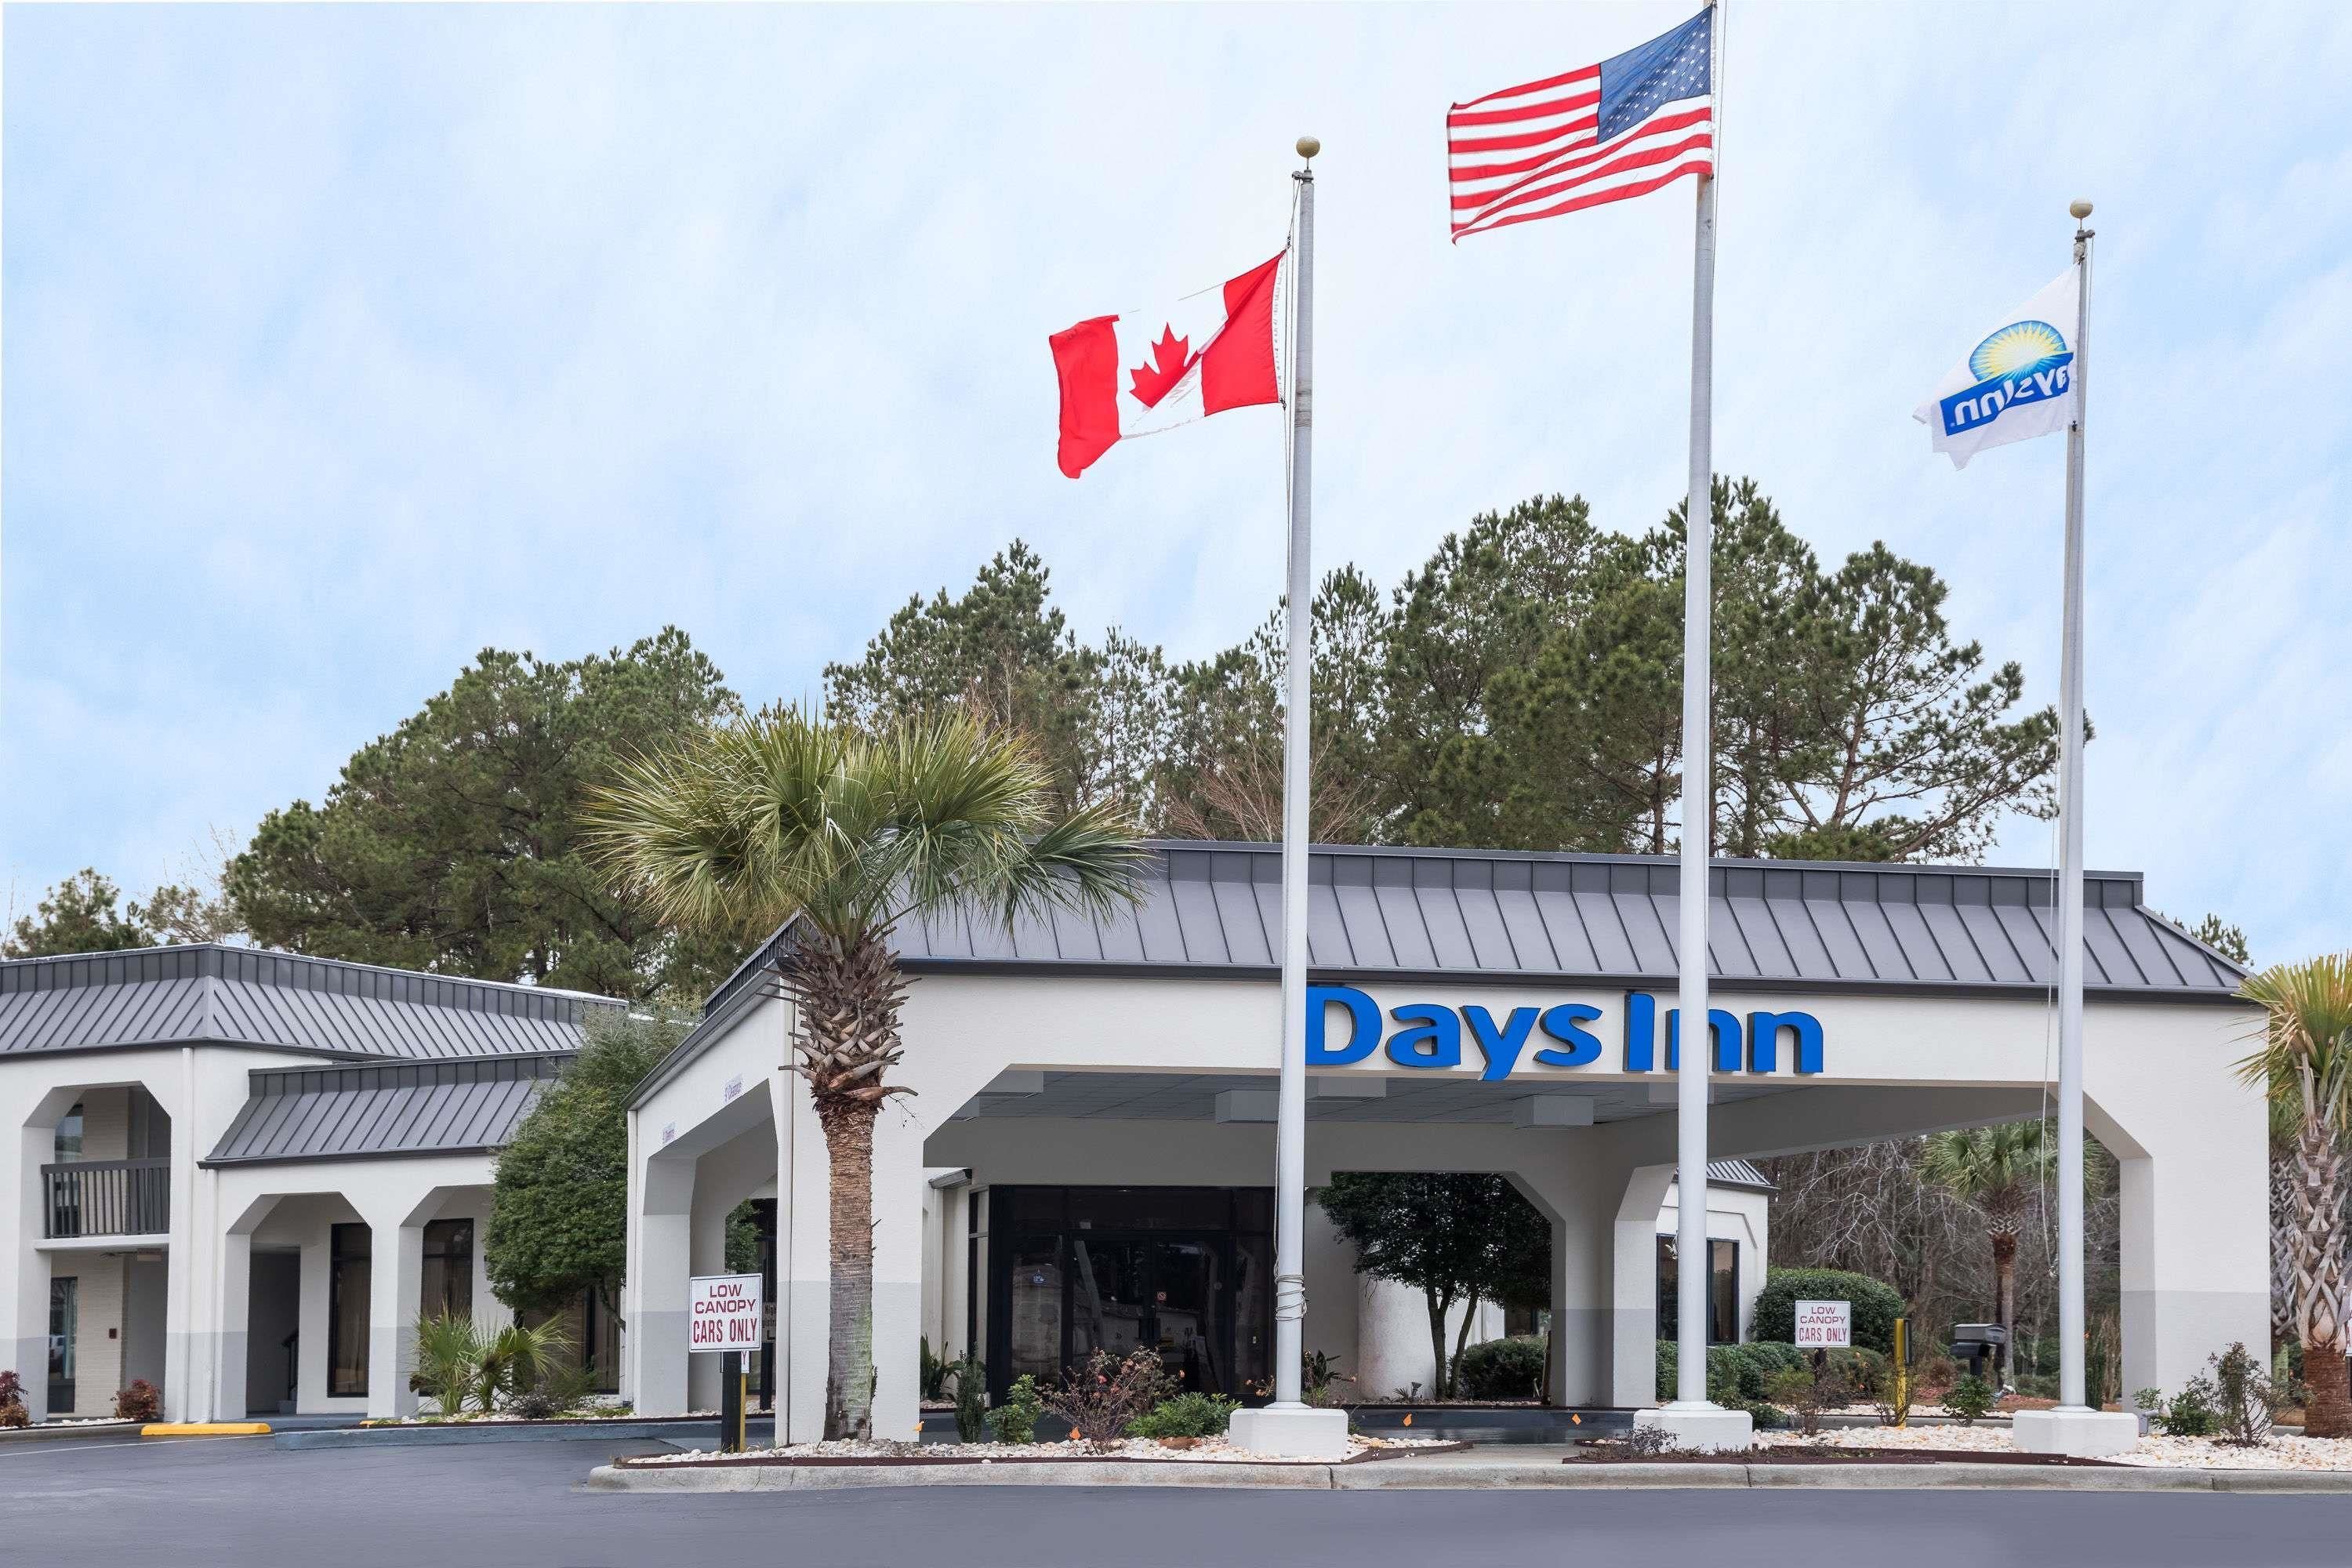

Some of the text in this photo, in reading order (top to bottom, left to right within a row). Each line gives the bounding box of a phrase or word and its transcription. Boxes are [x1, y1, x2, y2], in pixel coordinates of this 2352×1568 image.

[1305, 985, 1824, 1081] Days Inn
[710, 1283, 742, 1298] LOW
[695, 1299, 756, 1314] CANOPY
[1811, 1306, 1836, 1315] LOW
[1800, 1316, 1846, 1324] CANOPY
[693, 1318, 757, 1343] CARS ONLY
[1798, 1327, 1847, 1342] CARS ONLY
